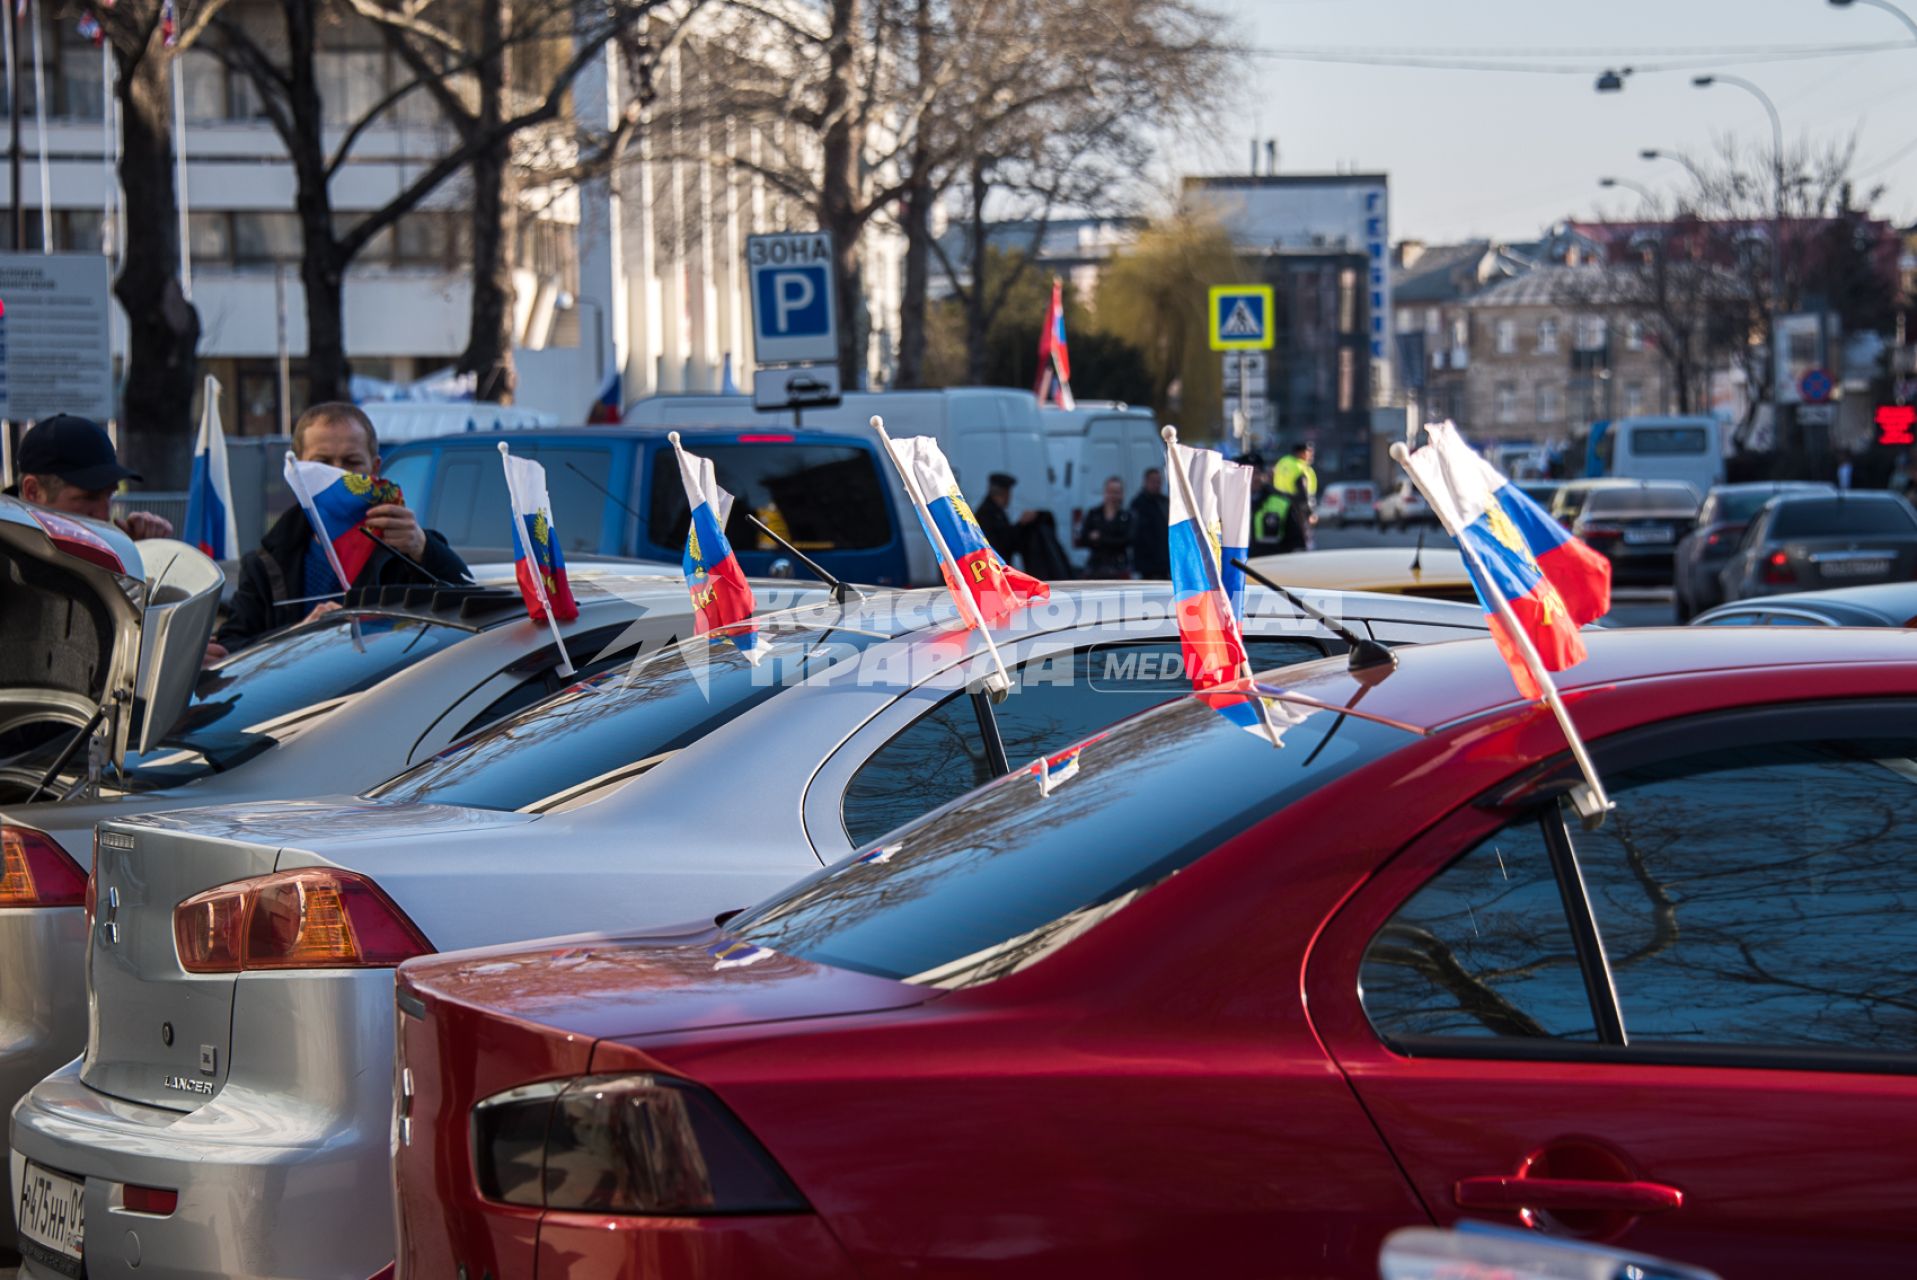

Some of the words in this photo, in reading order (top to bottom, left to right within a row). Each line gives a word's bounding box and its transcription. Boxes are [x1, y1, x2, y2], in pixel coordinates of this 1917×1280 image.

[752, 238, 829, 266] ЗОНА
[773, 272, 815, 333] P
[164, 1075, 214, 1095] LANCER
